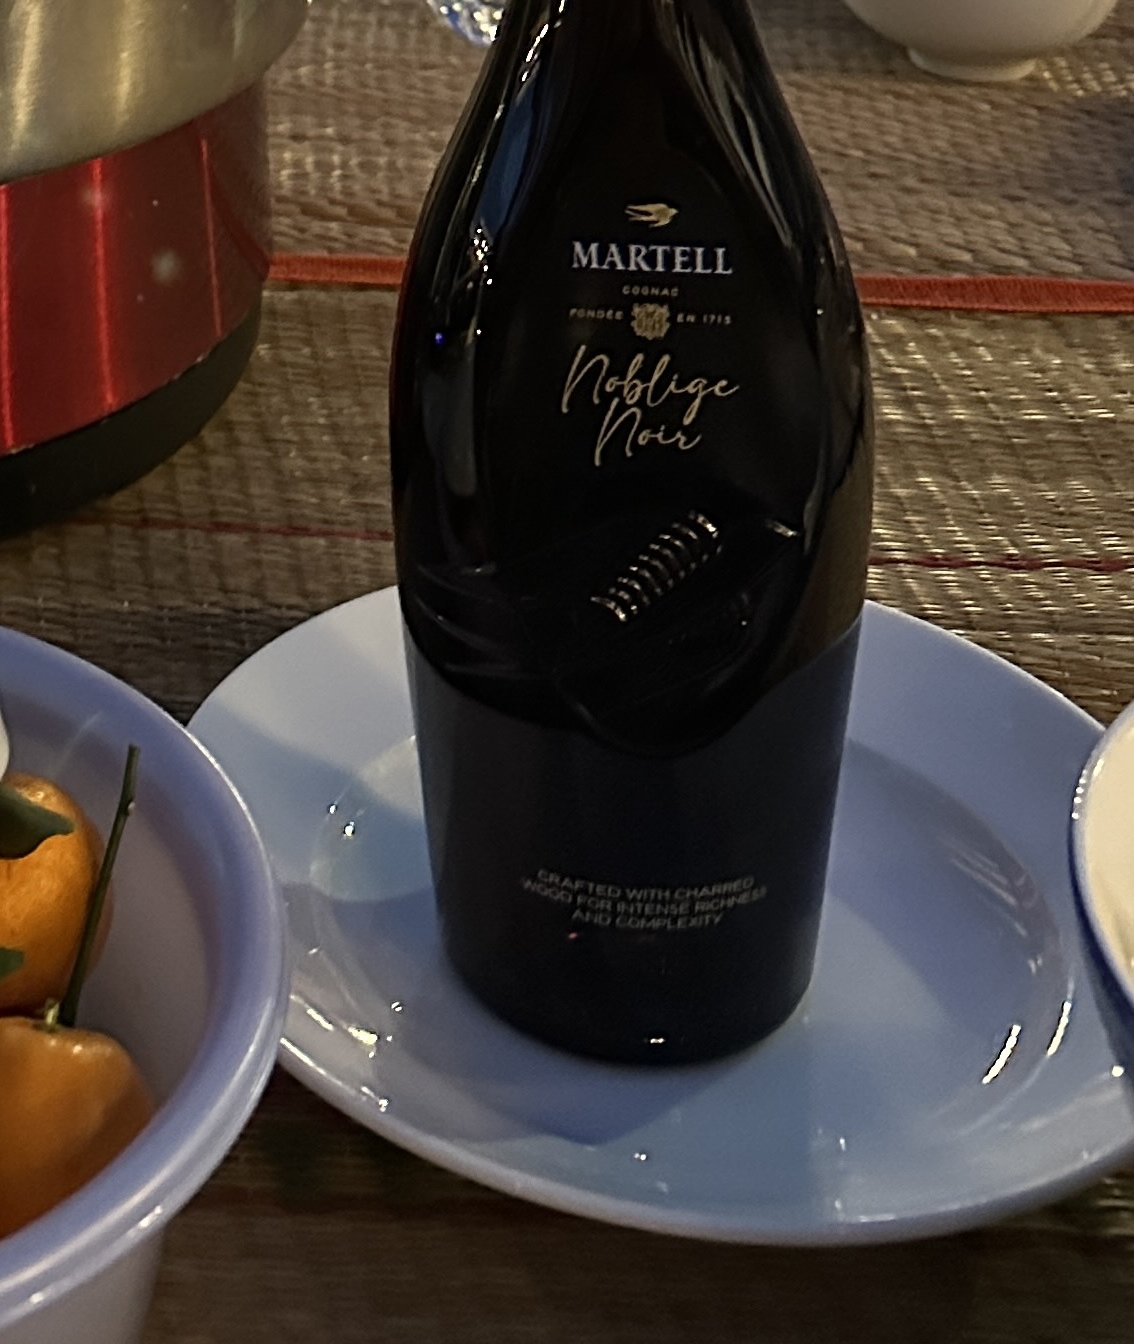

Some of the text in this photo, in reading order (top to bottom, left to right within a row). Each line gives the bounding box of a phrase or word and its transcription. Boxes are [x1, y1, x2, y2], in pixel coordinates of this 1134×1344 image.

[571, 240, 733, 275] MARTELL
[622, 284, 680, 297] COGNAC
[676, 313, 696, 324] EN
[561, 344, 740, 426] Noblige
[593, 397, 703, 467] Noir
[522, 878, 767, 916] WOOD FOR INTENSE RICHNESS
[538, 868, 755, 900] CRAFTED WITH CHARRED
[571, 909, 724, 930] AND COMPLEXITY
